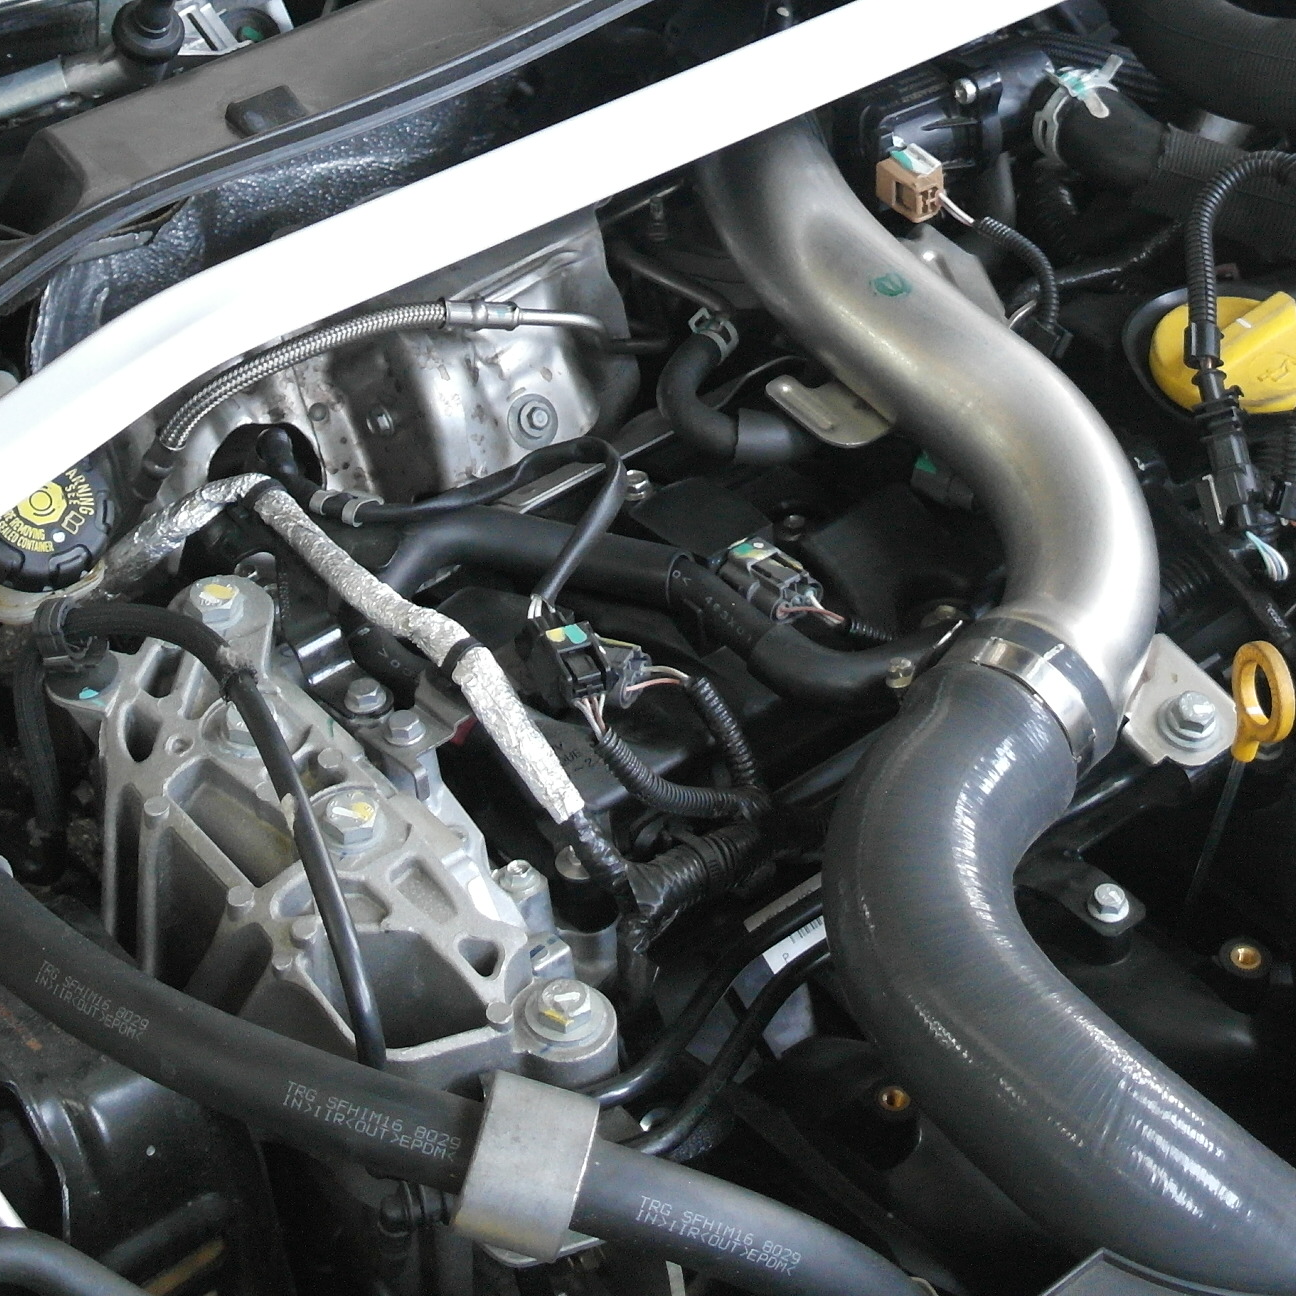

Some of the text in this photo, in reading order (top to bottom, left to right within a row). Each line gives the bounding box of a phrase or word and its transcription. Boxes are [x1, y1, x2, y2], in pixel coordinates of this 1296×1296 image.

[65, 468, 95, 516] ARNING
[65, 484, 80, 506] SEE
[9, 517, 46, 541] REMOVING
[17, 536, 55, 553] CONTAINER
[287, 1080, 317, 1102] TRG
[414, 1125, 462, 1150] 8029
[639, 1195, 673, 1217] TRG
